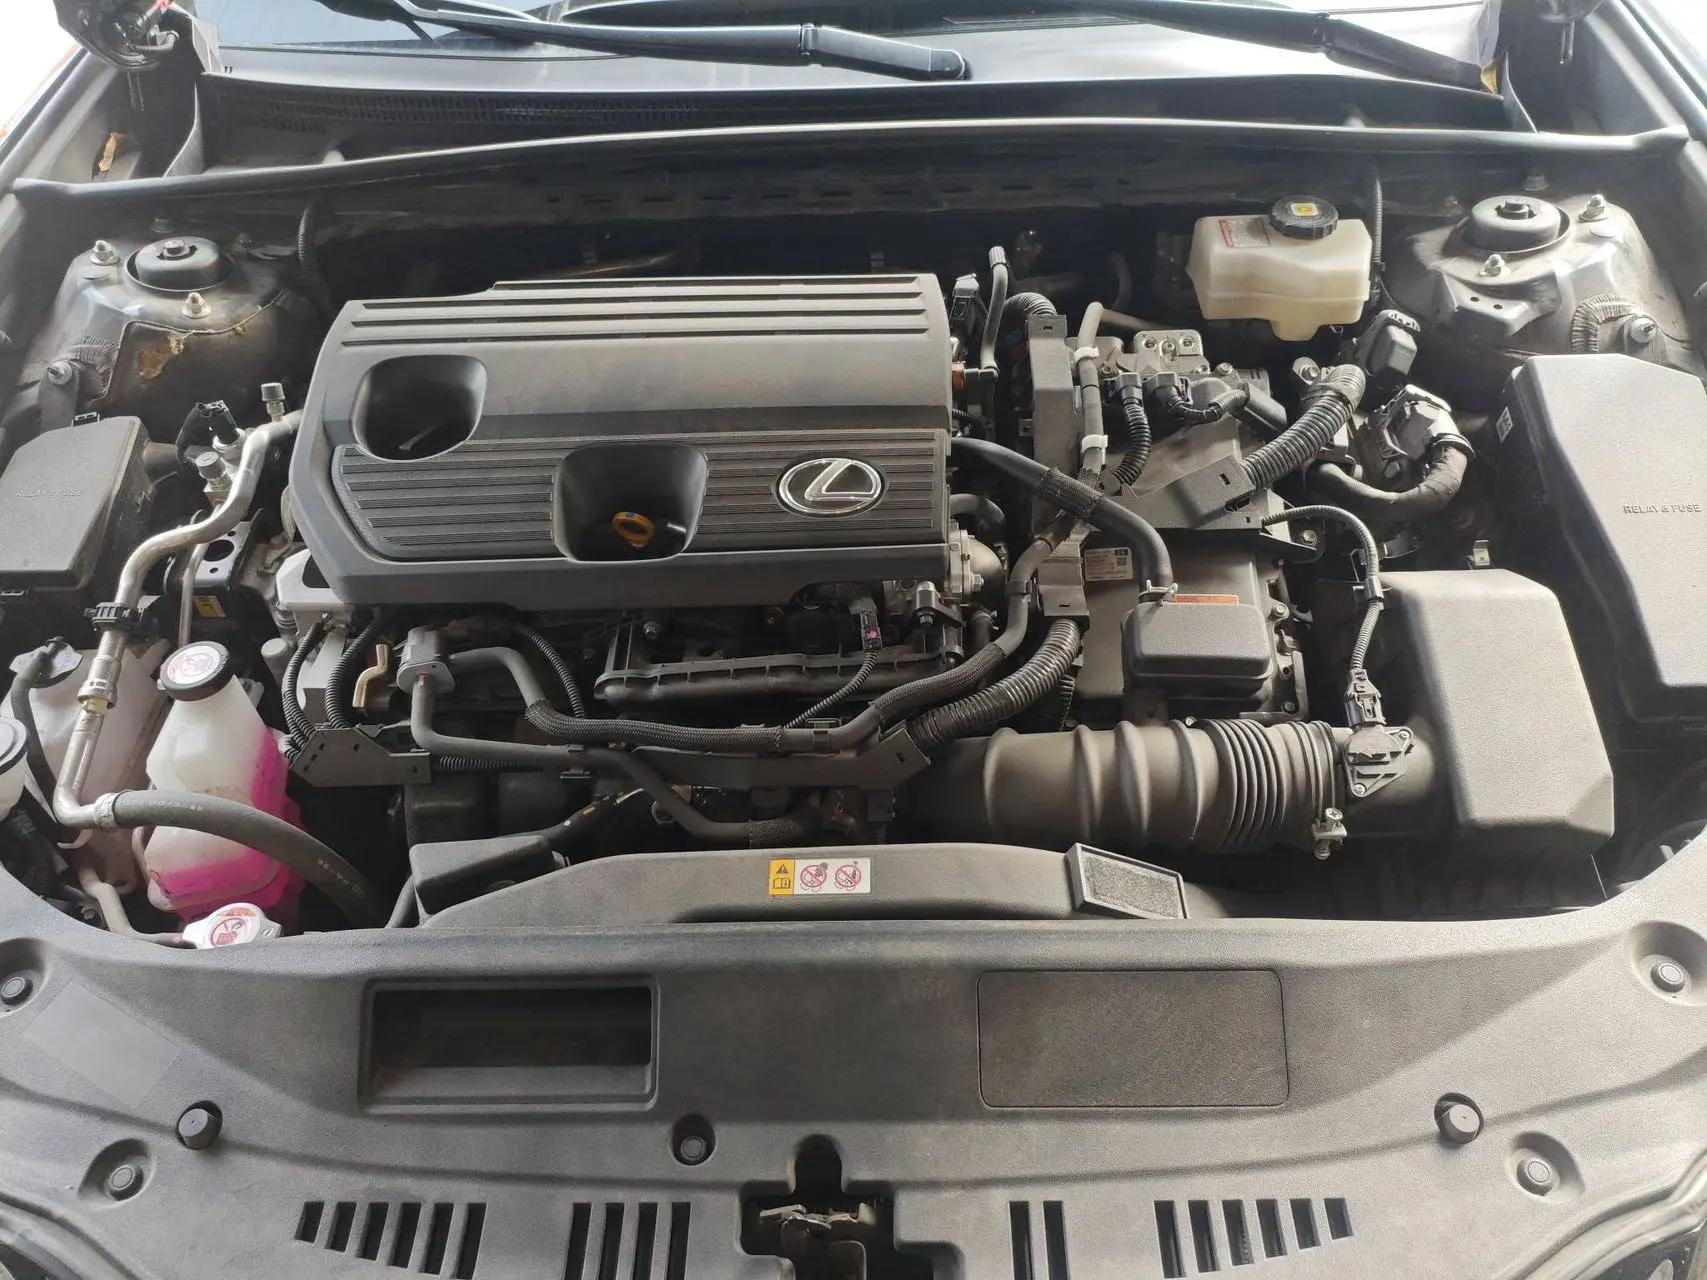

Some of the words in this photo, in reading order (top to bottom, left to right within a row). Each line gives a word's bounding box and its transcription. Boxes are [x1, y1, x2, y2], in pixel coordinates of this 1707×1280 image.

[1623, 503, 1659, 514] RELAY
[1661, 503, 1670, 513] &
[1671, 503, 1702, 513] FUSE
